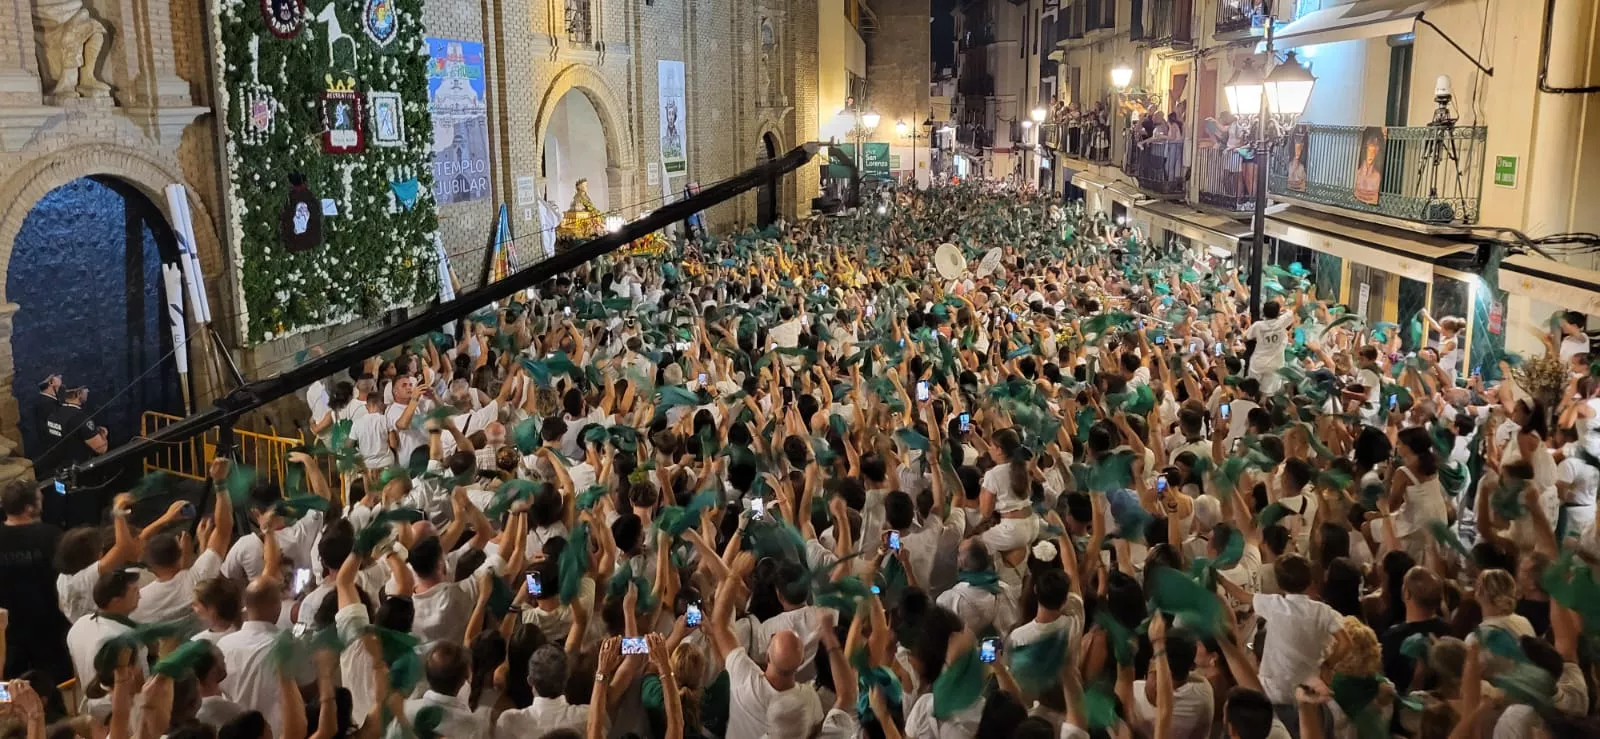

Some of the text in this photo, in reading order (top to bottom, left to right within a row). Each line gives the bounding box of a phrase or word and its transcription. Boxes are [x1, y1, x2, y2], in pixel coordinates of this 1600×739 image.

[435, 159, 485, 176] TEMPLO
[436, 177, 486, 196] JUBILAR
[1265, 334, 1279, 344] 10
